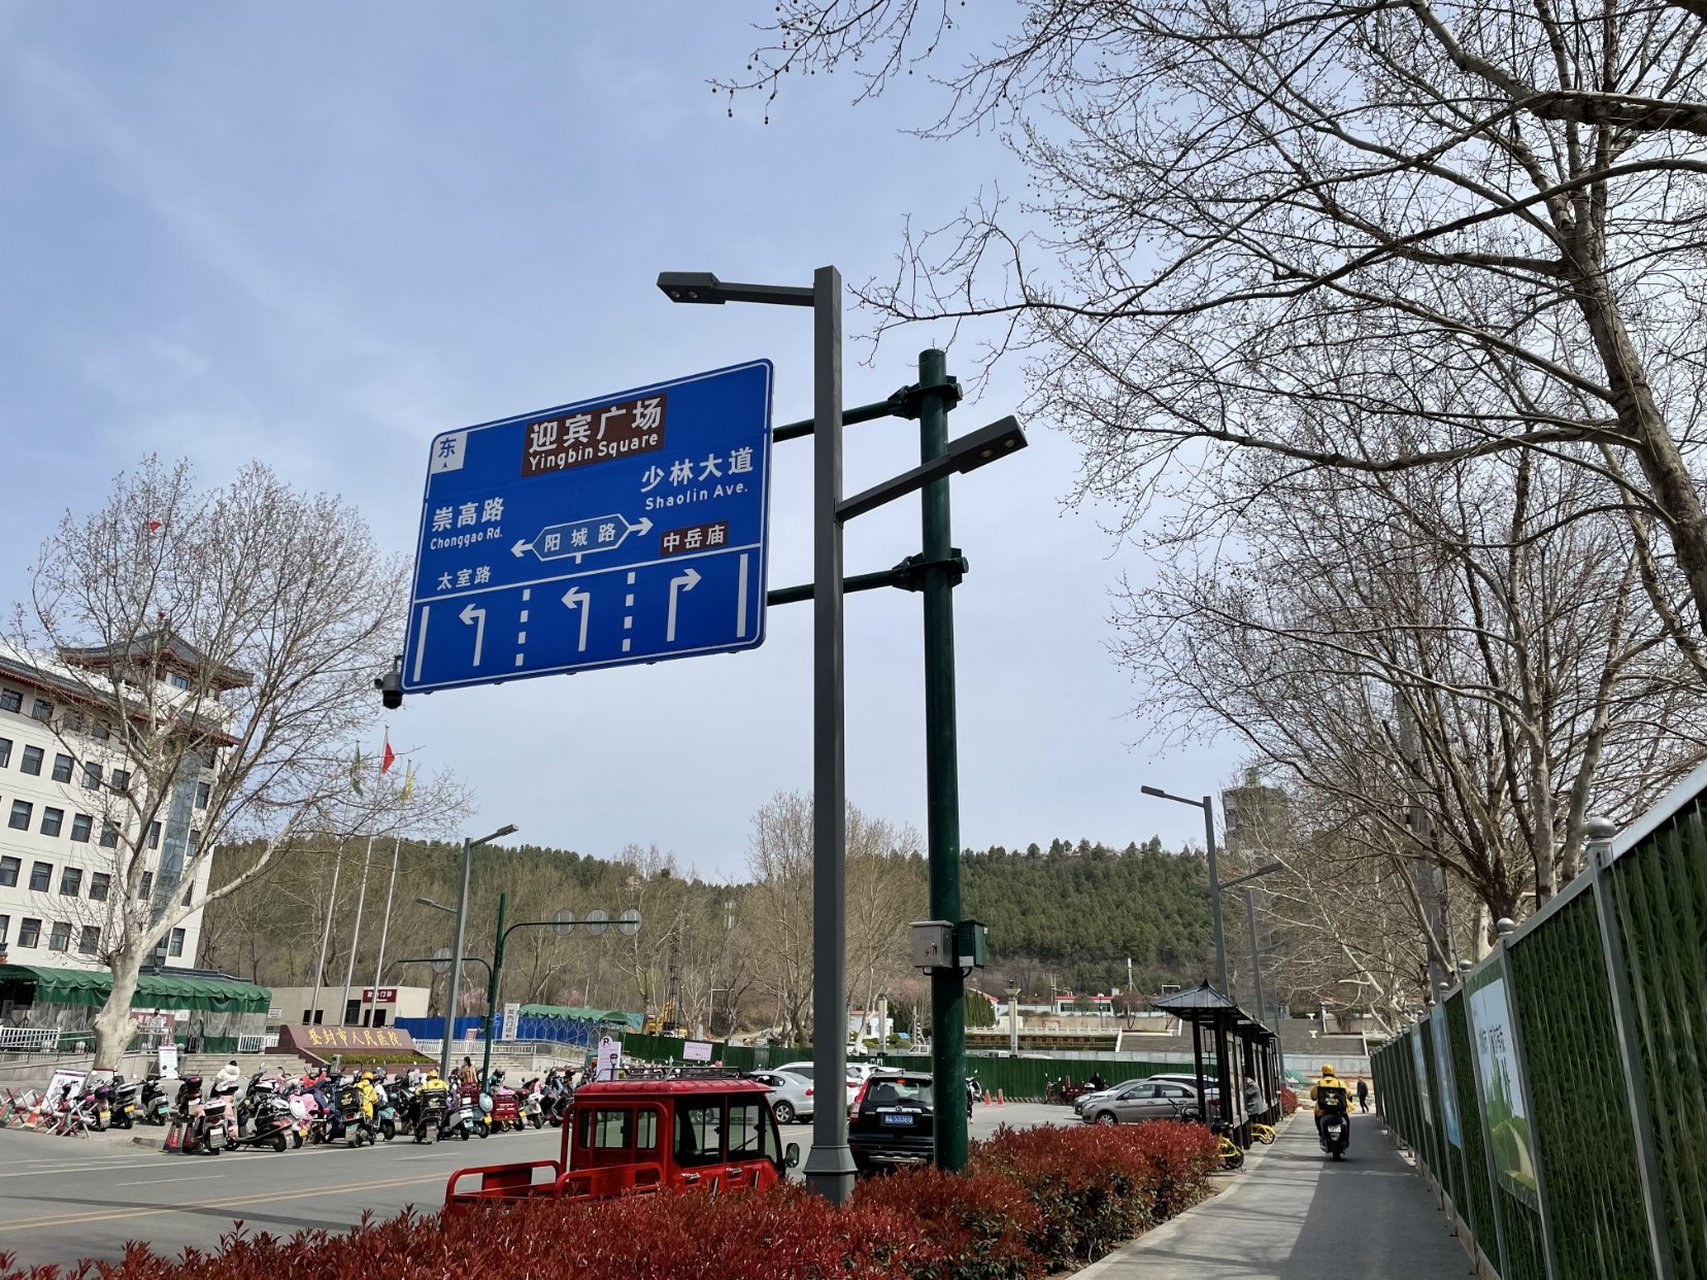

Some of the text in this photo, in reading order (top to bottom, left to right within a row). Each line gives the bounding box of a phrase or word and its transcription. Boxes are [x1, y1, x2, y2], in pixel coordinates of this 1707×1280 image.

[528, 397, 662, 454] 迎宾广场
[438, 438, 456, 458] 东
[529, 433, 658, 471] Yingbin Square
[641, 446, 753, 493] 少林大道
[645, 482, 748, 510] Shaolin Ave.
[432, 496, 504, 532] 崇高路
[430, 526, 503, 550] Chonggao Rd.
[544, 523, 616, 553] 阳城路
[663, 524, 725, 553] 中岳庙
[437, 565, 491, 591] 太室路
[308, 1028, 402, 1047] 登封市人民医院
